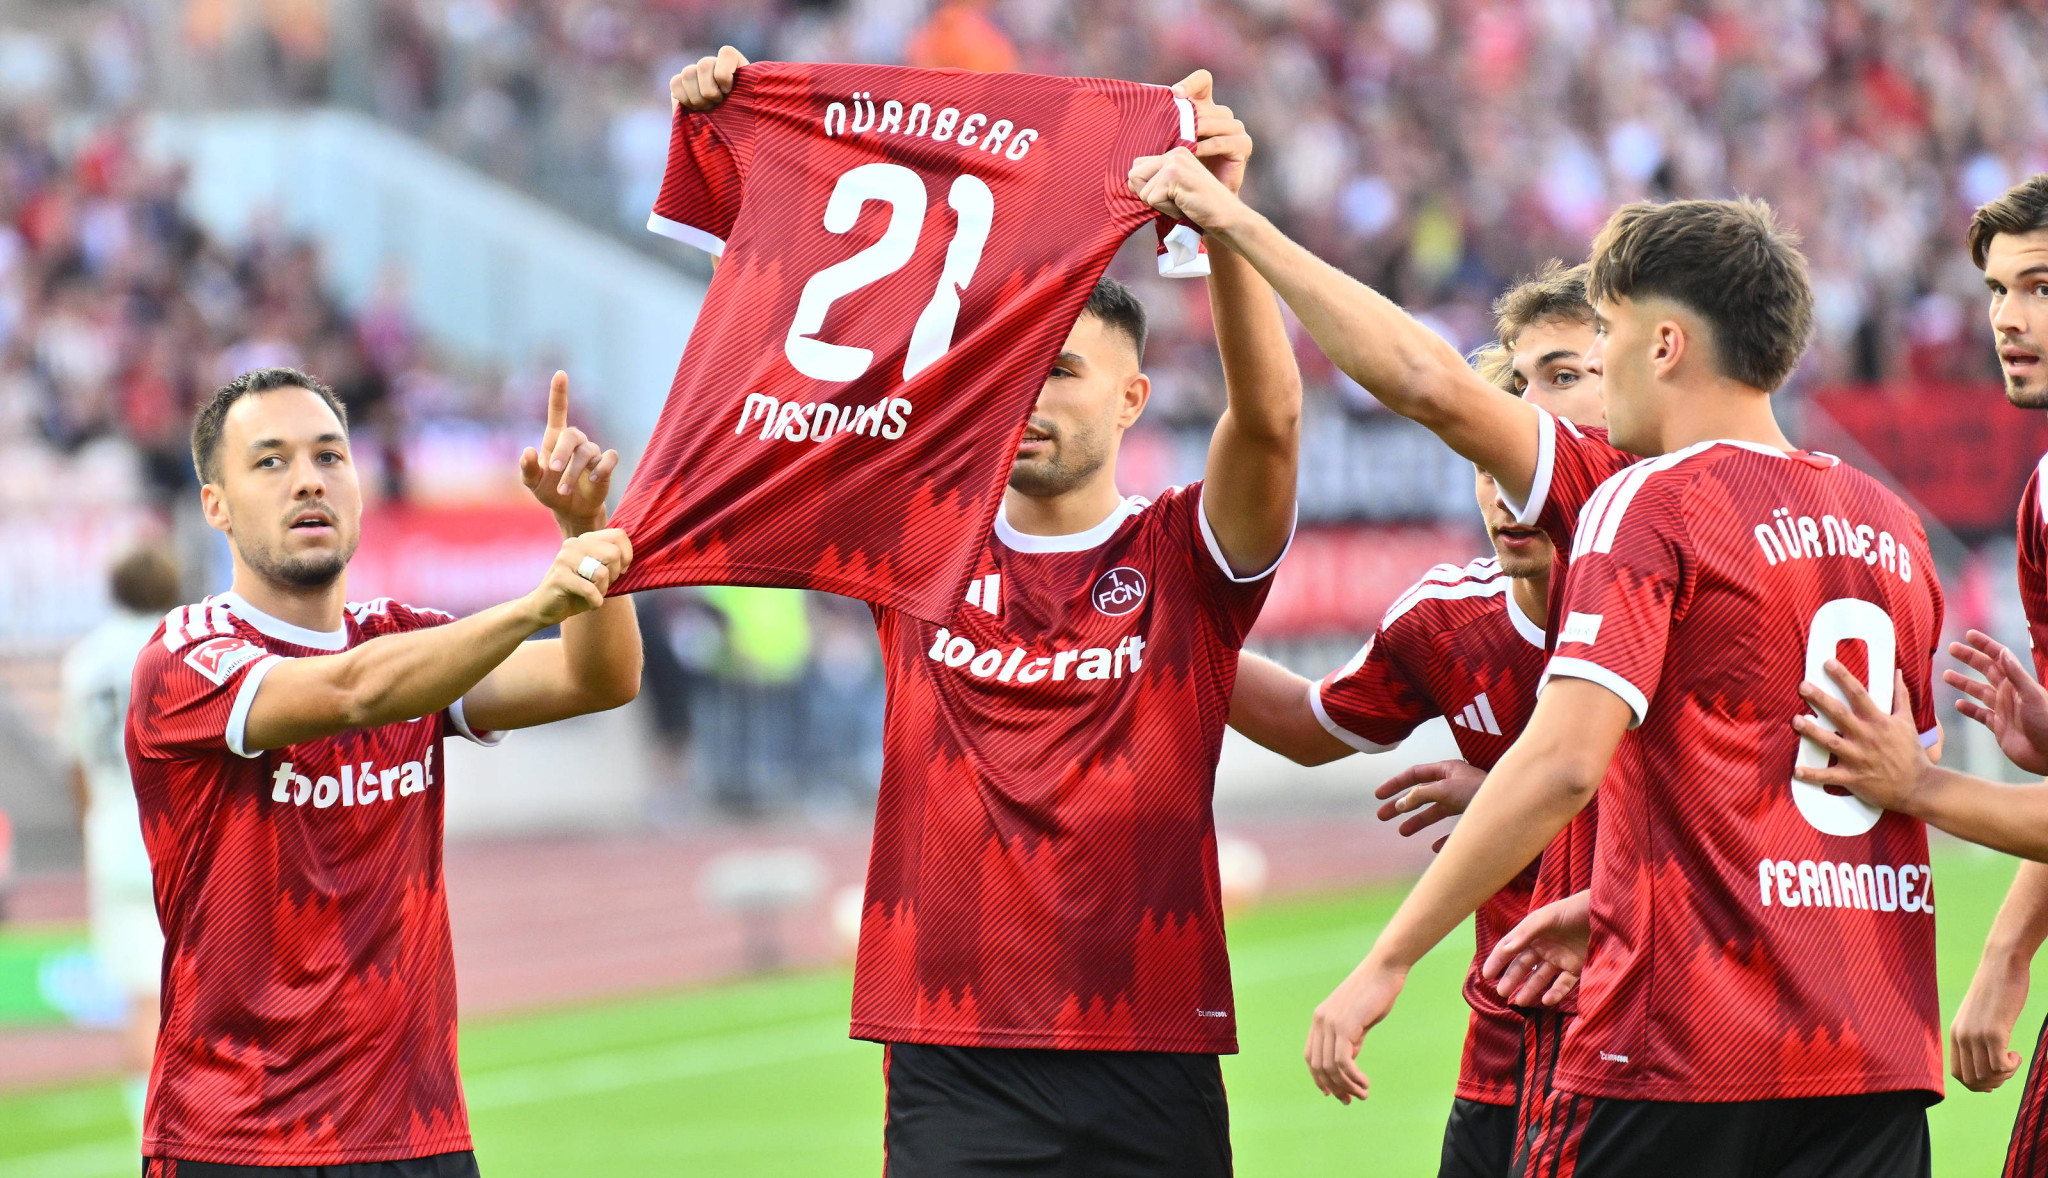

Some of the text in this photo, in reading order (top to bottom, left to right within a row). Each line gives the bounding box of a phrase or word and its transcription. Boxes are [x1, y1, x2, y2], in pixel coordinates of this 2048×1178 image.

[824, 91, 1039, 161] NÜRNBERG
[784, 162, 995, 382] 21
[1098, 580, 1143, 610] FCN
[928, 627, 1146, 684] toolcraft
[271, 744, 434, 809] toolcraf
[1758, 858, 1935, 914] FERNANDEZ
